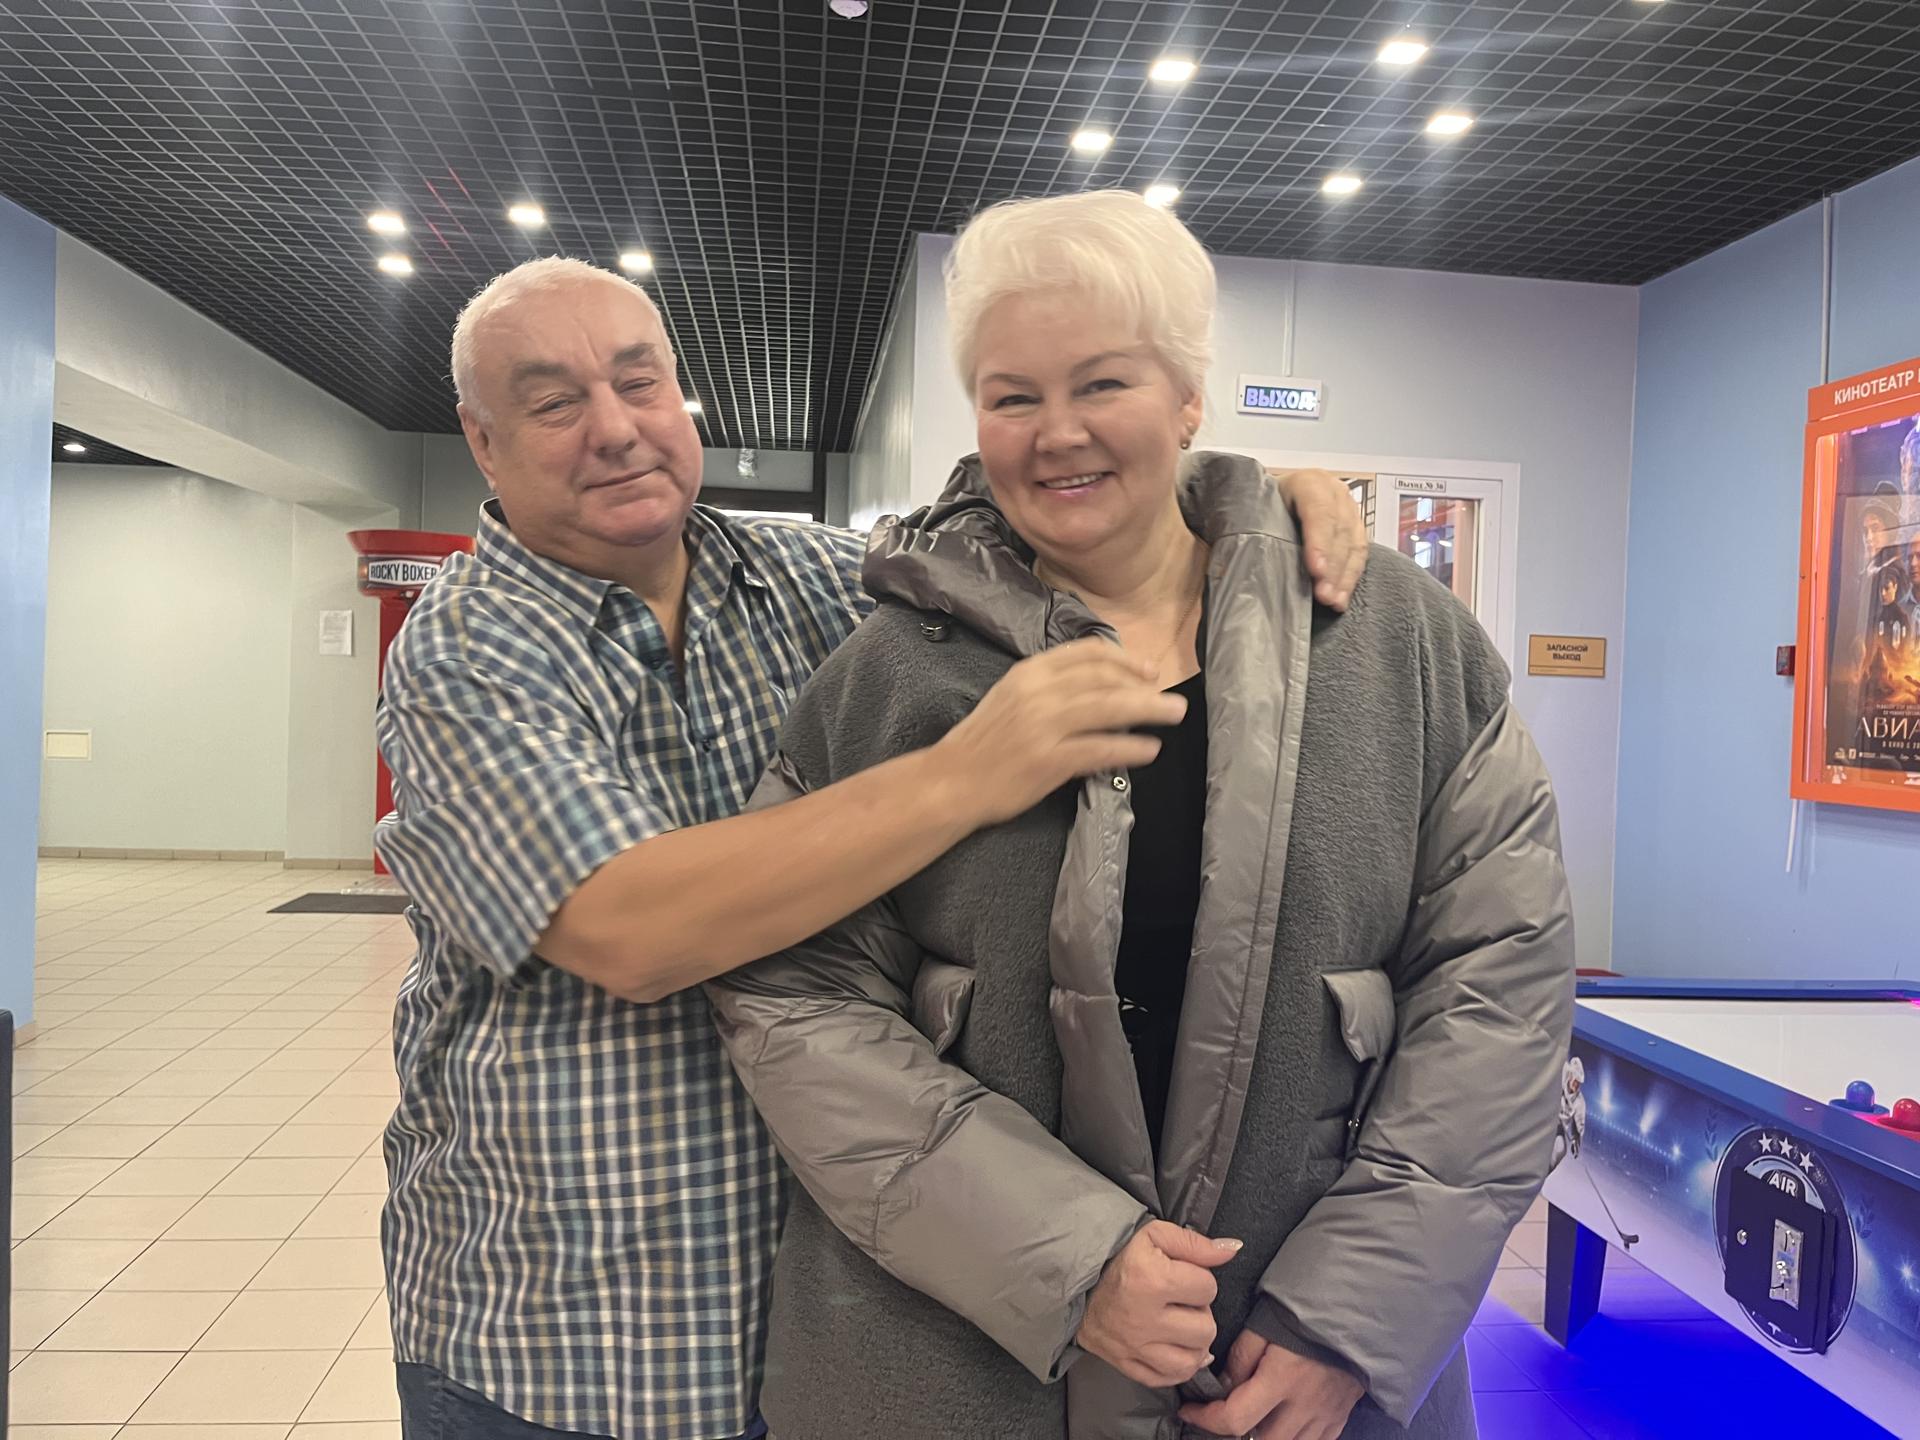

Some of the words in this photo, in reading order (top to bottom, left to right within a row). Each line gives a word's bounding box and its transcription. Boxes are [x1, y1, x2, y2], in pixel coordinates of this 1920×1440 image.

[1833, 370, 1915, 406] КИНОТЕАТР
[1245, 387, 1315, 411] ВЫХОД
[370, 563, 400, 582] ROCKY
[1546, 642, 1589, 653] ЗАПАСНОЙ
[1552, 653, 1581, 662] ВЫХОД
[1768, 1172, 1797, 1198] AIR
